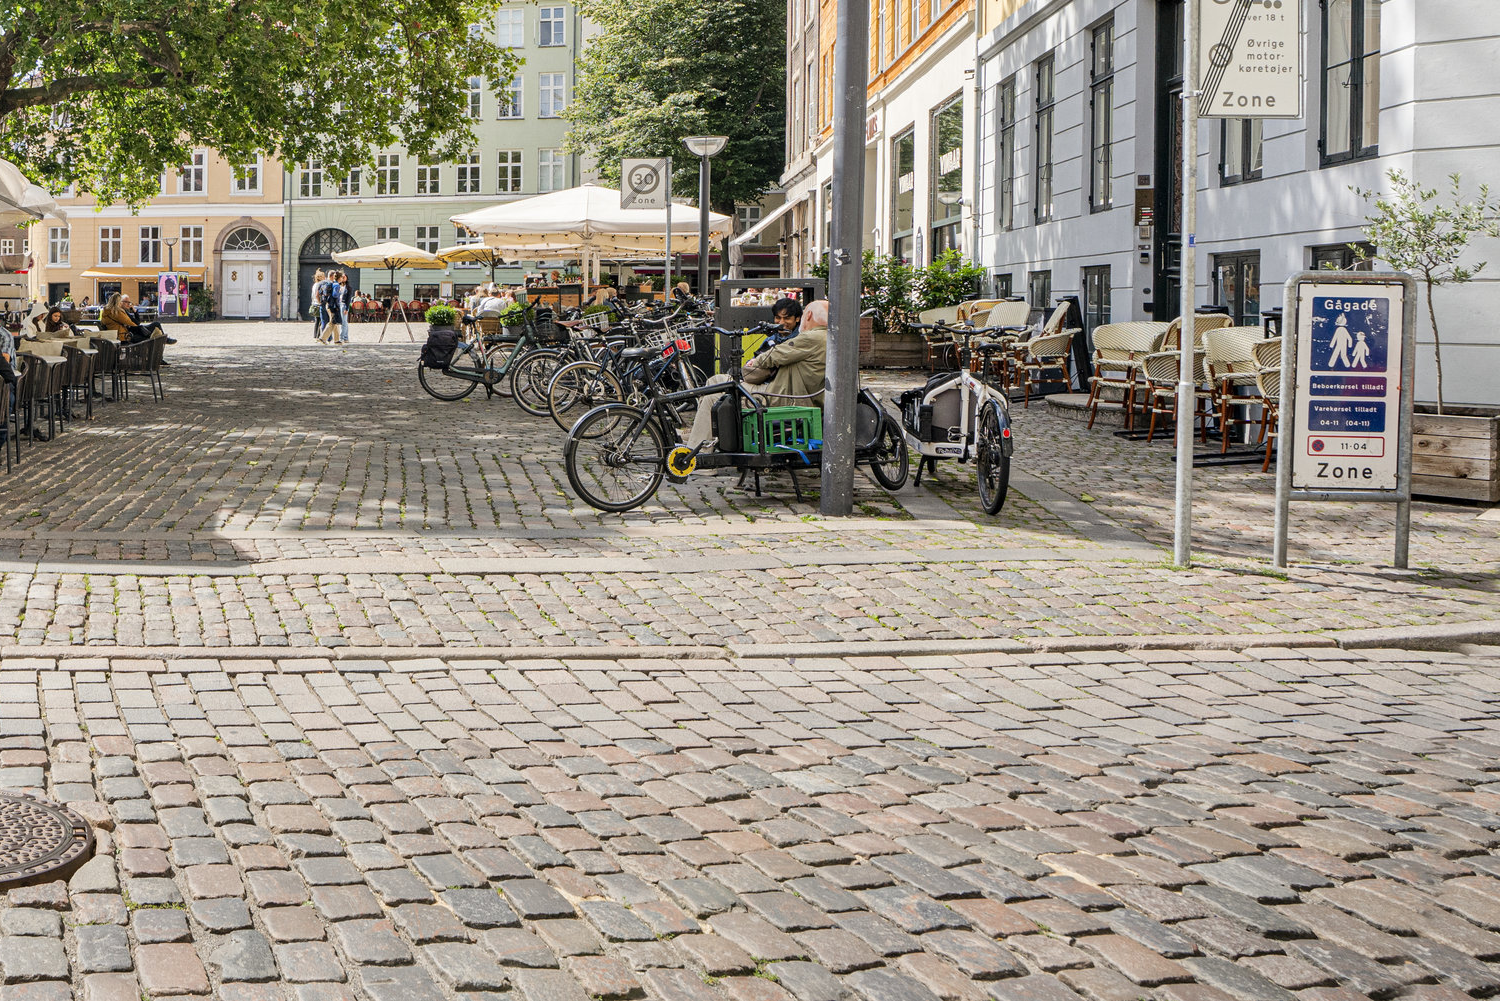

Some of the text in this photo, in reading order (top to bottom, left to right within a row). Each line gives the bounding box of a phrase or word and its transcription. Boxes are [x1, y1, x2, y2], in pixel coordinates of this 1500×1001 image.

[1266, 13, 1276, 21] 18
[1280, 14, 1285, 22] t
[1247, 39, 1284, 49] Øvrige
[1238, 64, 1293, 74] køretøjer
[1222, 91, 1276, 107] Zone
[634, 173, 654, 185] 30
[1324, 299, 1378, 312] Gågade
[1312, 382, 1359, 390] Beboerkørsel
[1345, 419, 1370, 427] (04-11)
[1341, 442, 1367, 451] 11-04
[1316, 462, 1373, 479] Zone
